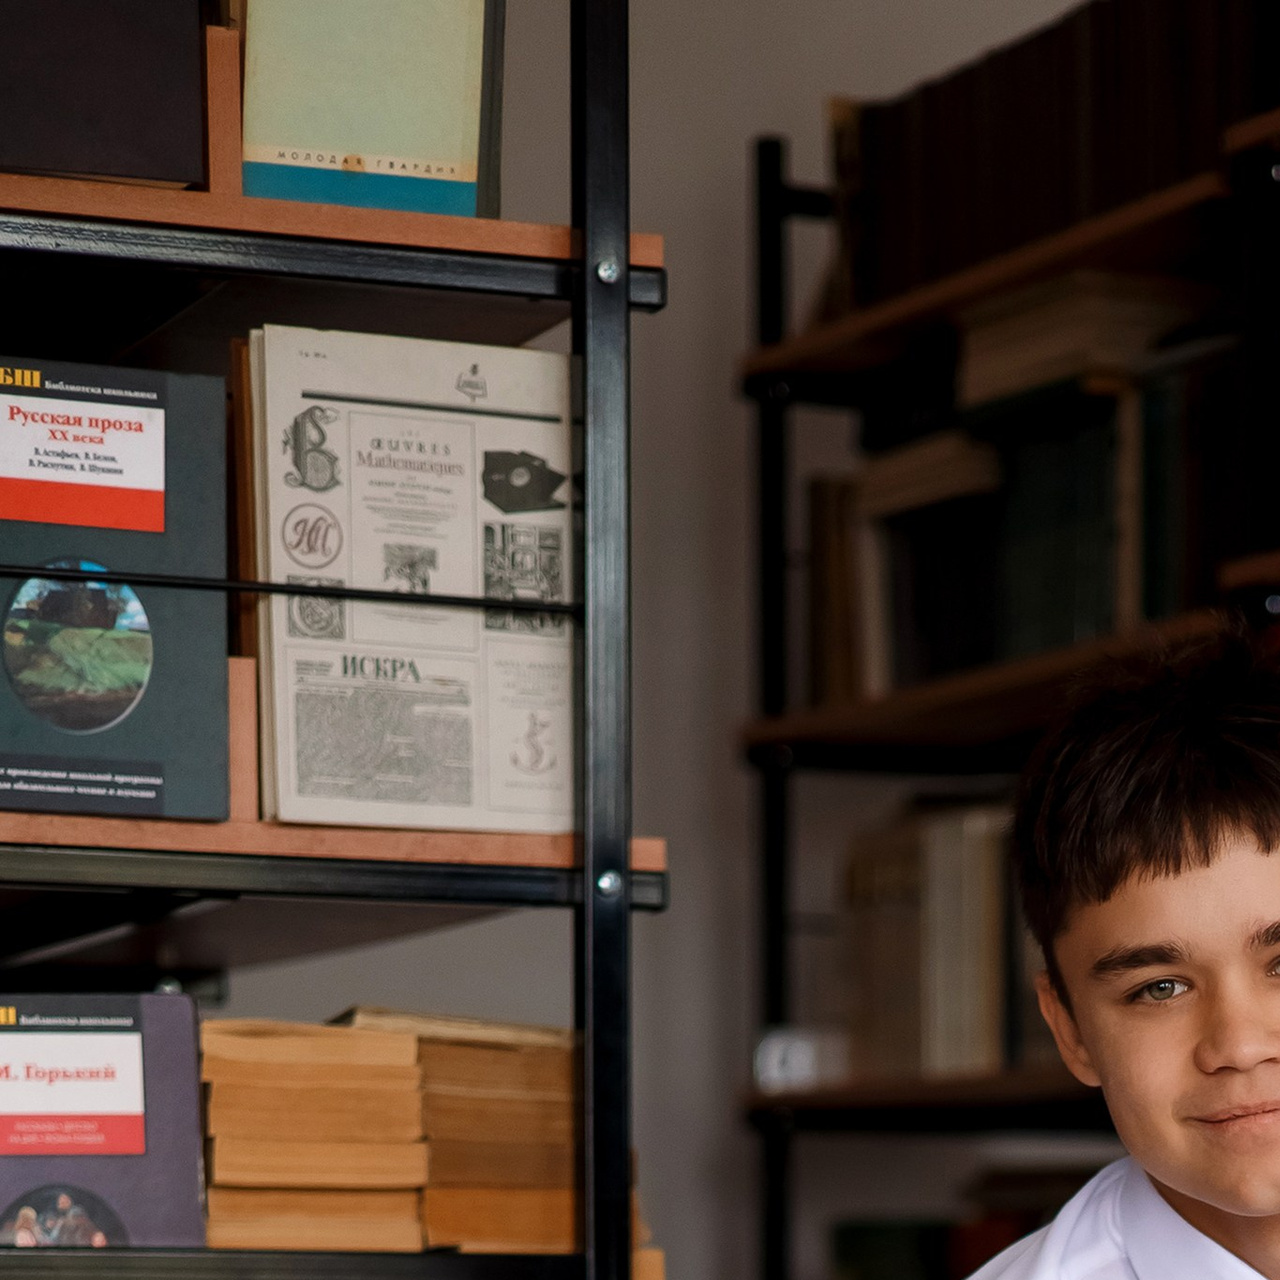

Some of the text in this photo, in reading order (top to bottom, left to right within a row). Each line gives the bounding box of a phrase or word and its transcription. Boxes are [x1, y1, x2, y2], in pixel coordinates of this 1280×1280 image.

[276, 150, 456, 174] МОЛОДАЯ ГВАРДИЯ
[8, 404, 144, 434] Русская проза
[72, 434, 105, 445] века
[341, 653, 422, 684] ИСКРА
[24, 1062, 117, 1086] Горький
